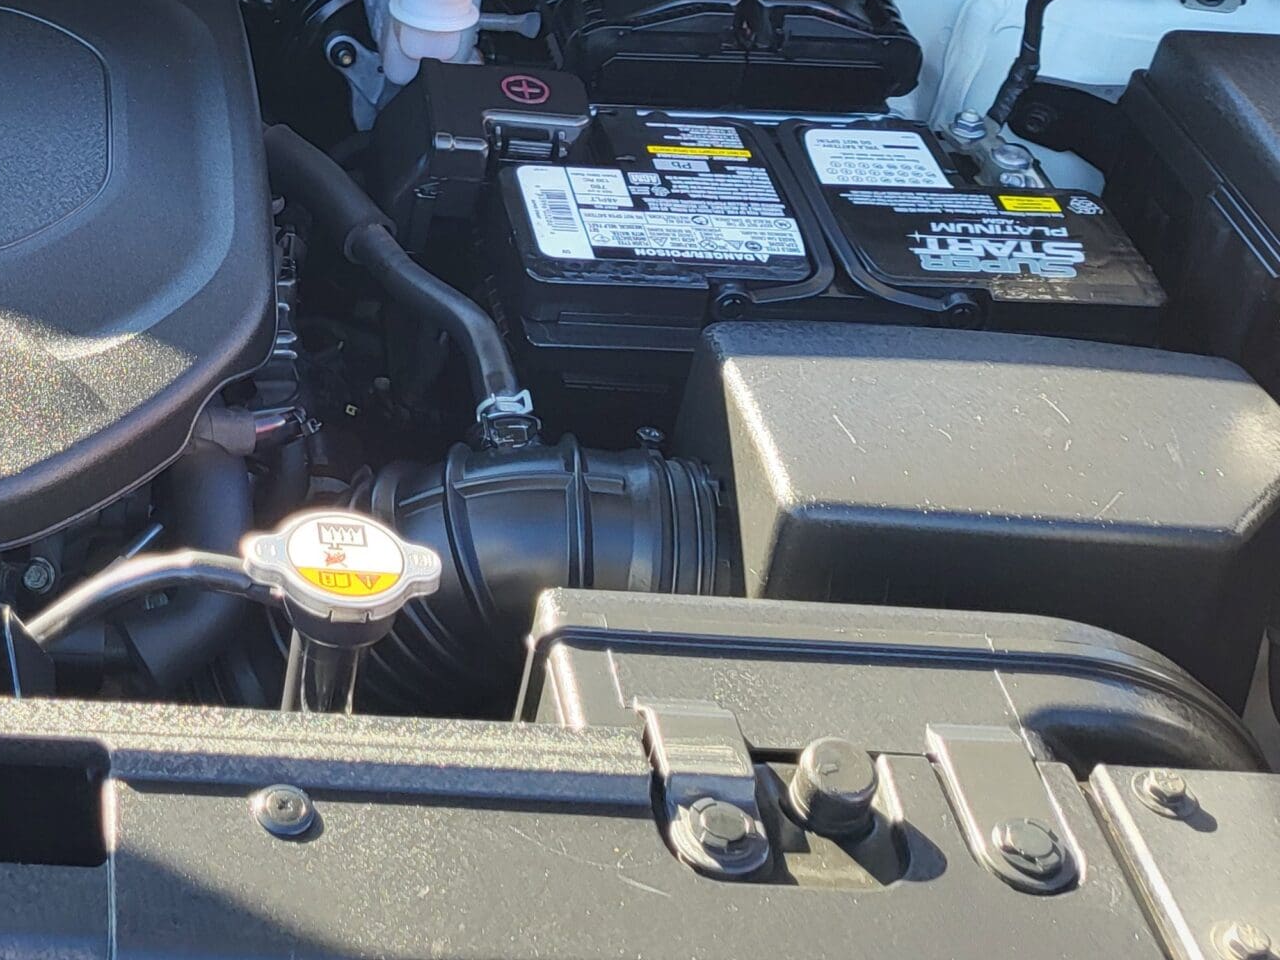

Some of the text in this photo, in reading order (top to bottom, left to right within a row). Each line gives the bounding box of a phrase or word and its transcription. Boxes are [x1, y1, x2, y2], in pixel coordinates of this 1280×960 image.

[671, 161, 692, 170] Pb
[930, 222, 1069, 238] PLATINUM
[909, 238, 1086, 263] START
[919, 253, 1078, 278] SUPER
